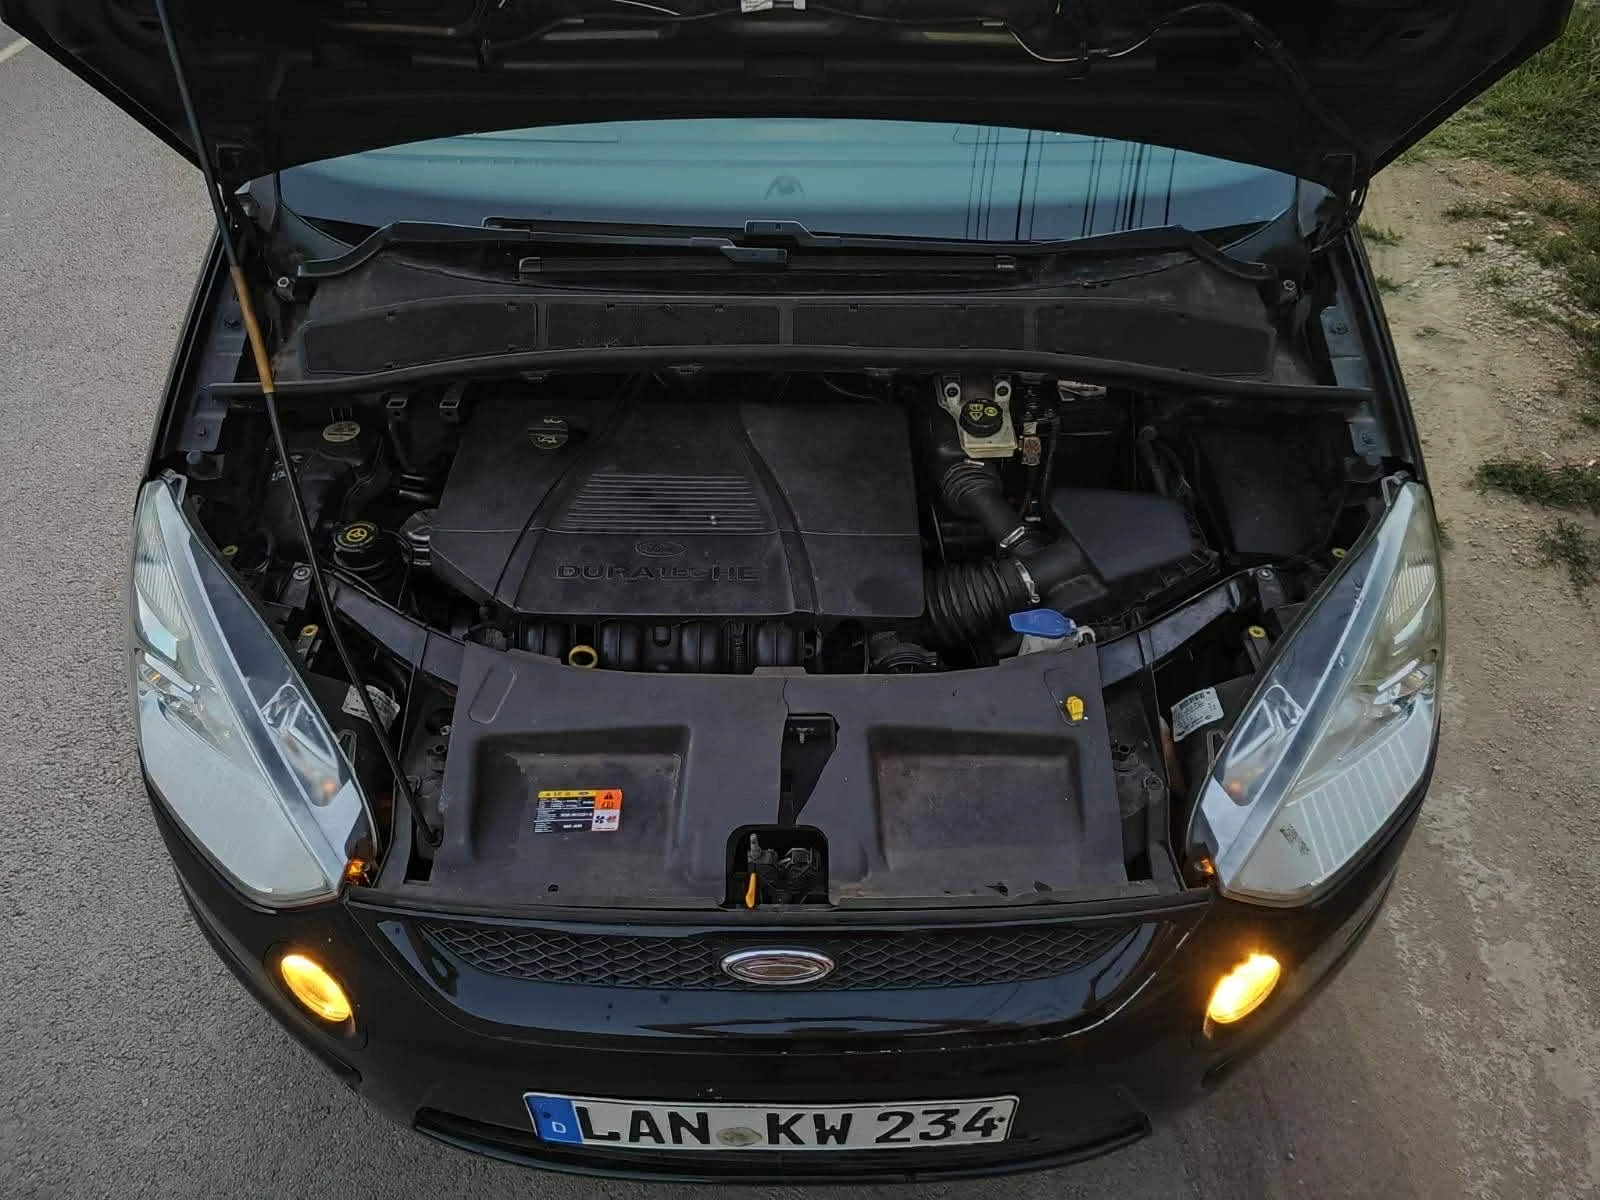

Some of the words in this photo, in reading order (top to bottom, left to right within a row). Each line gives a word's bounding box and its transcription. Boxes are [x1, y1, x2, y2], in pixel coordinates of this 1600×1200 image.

[576, 1106, 711, 1145] LAN
[766, 1112, 853, 1145] KW
[875, 1106, 1000, 1145] 234
